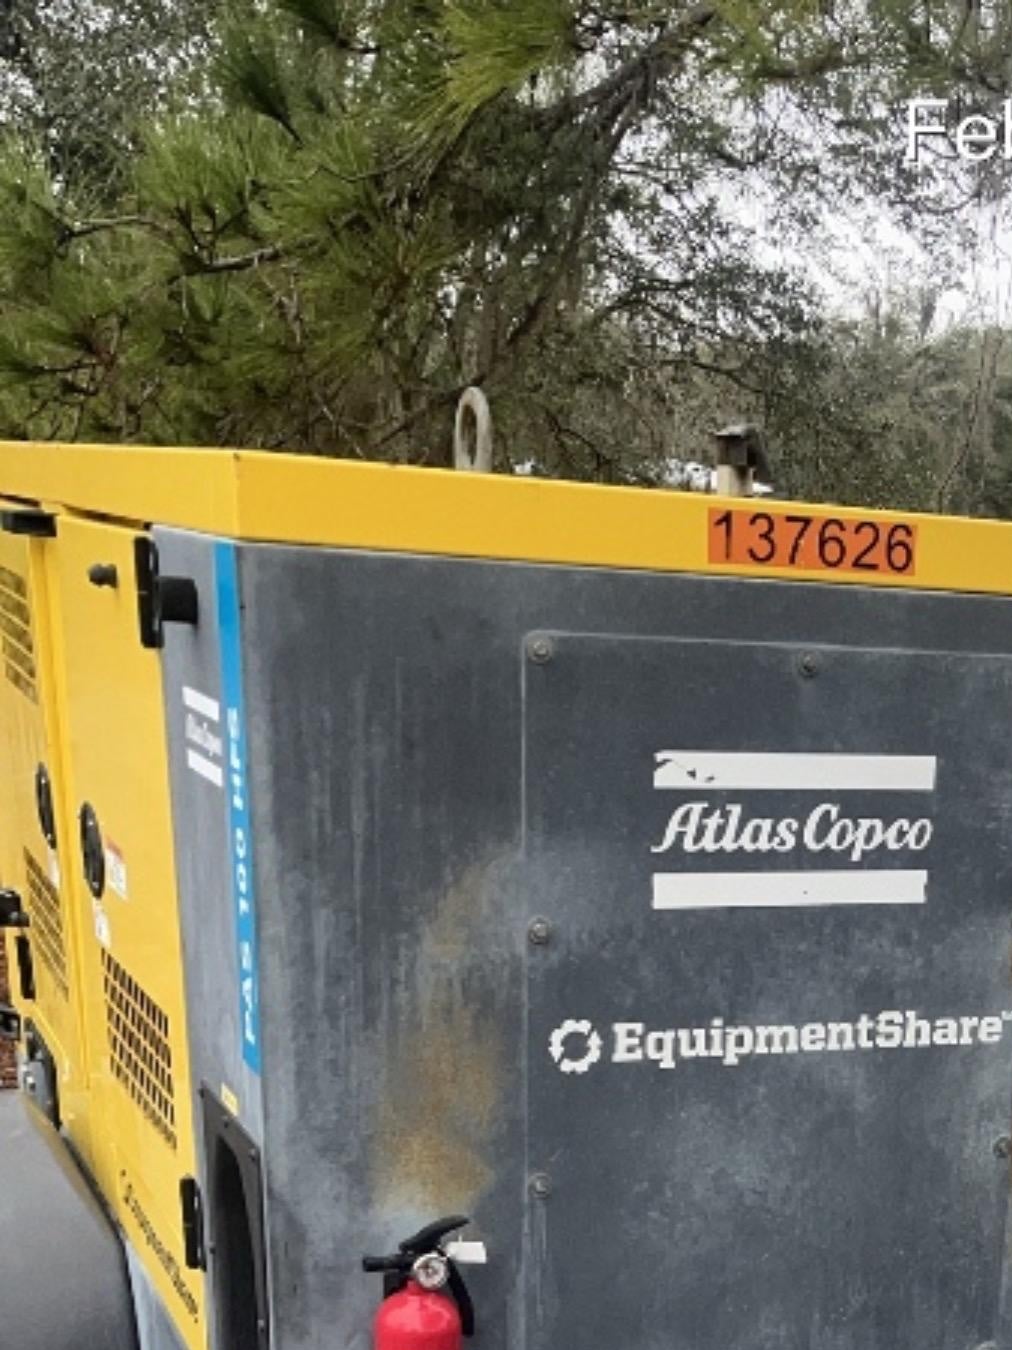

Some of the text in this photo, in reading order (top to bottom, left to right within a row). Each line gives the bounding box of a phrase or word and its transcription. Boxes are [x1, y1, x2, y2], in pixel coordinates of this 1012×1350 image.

[713, 509, 914, 573] 137626
[651, 802, 934, 862] Atlas Copco
[235, 826, 250, 917] 100
